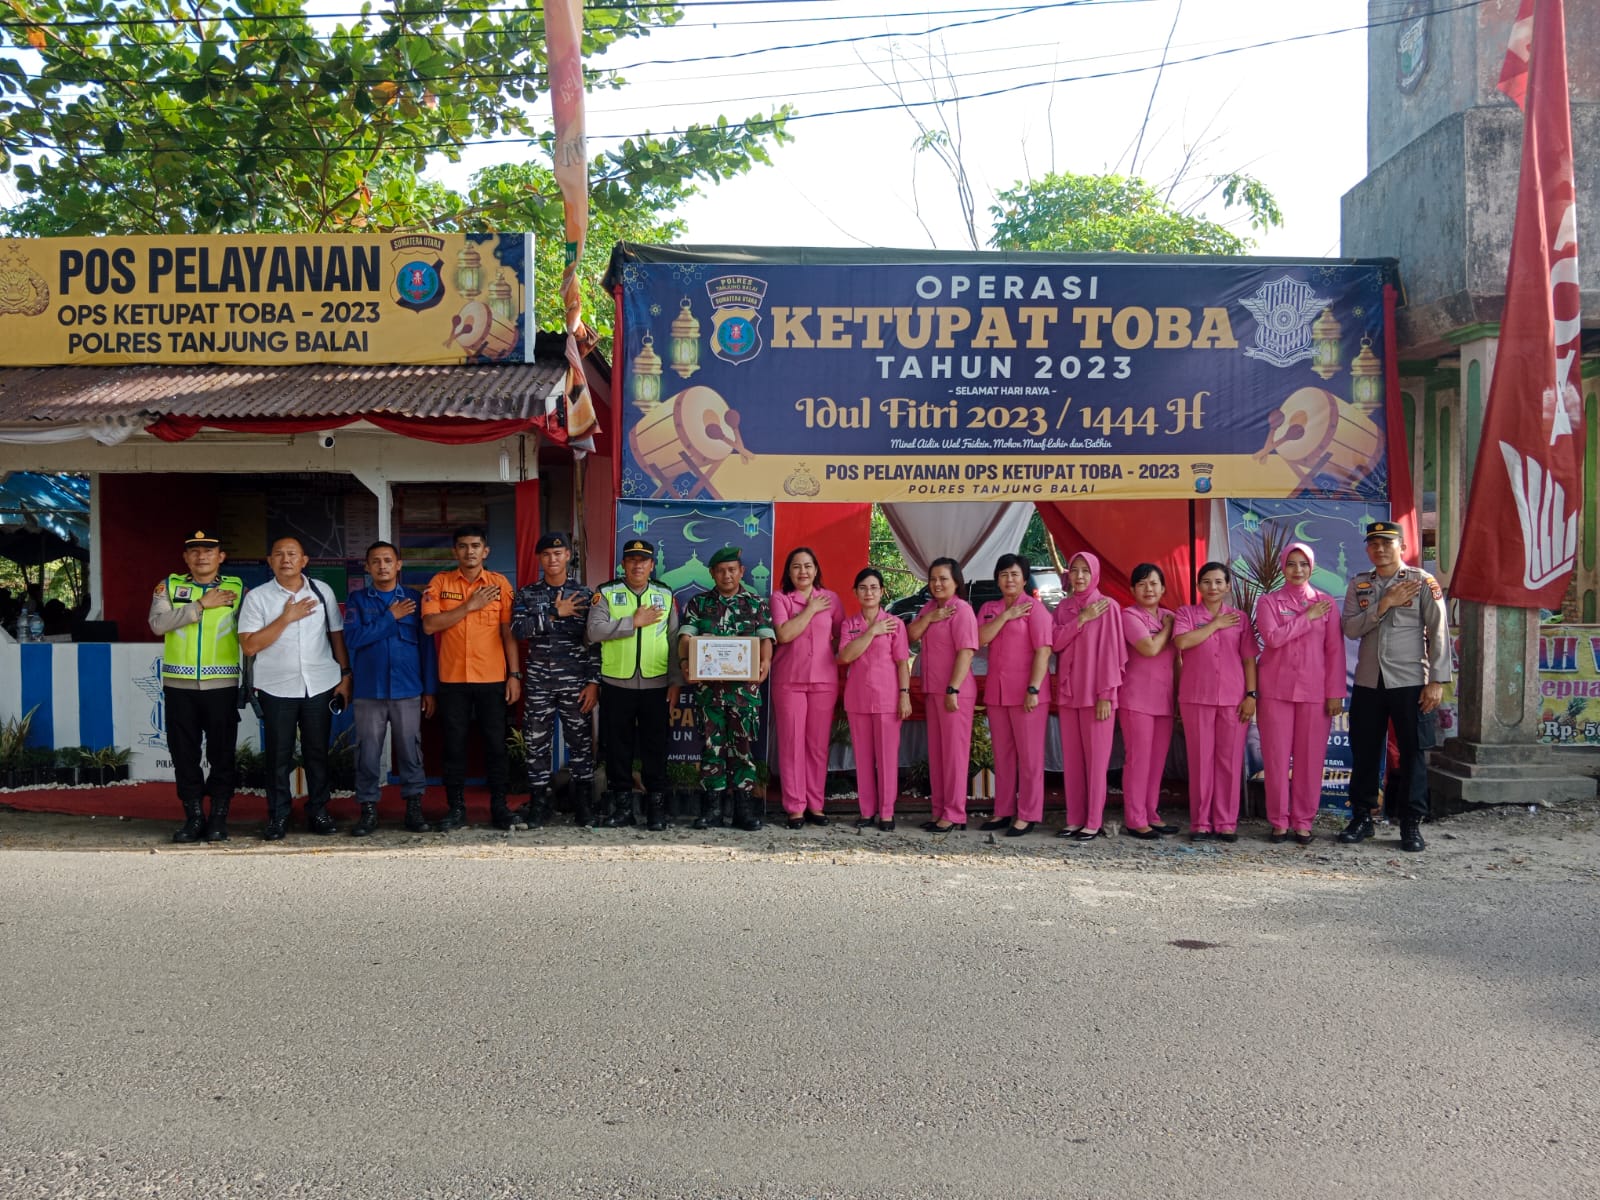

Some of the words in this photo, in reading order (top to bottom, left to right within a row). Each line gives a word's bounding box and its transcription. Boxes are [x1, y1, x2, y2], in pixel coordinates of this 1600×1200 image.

[59, 248, 136, 295] POS
[148, 246, 381, 292] PELAYANAN
[915, 275, 1098, 300] OPERASI
[57, 304, 107, 326] OPS
[113, 303, 220, 325] KETUPAT
[225, 302, 295, 324] TOBA
[321, 302, 381, 324] 2023
[770, 306, 1058, 349] KETUPAT
[1072, 306, 1239, 350] TOBA
[68, 332, 162, 354] POLRES
[168, 331, 289, 353] TANJUNG
[295, 331, 369, 352] BALAI
[876, 355, 1013, 379] TAHUN
[1034, 355, 1132, 379] 2023
[955, 386, 999, 396] SELAMAT
[1000, 386, 1023, 396] HARI
[1025, 386, 1050, 396] RAYA
[795, 396, 871, 429] Idul
[879, 398, 958, 429] Fitri
[966, 406, 1048, 436] 2023
[1055, 397, 1072, 430] /
[1079, 406, 1159, 436] 1444
[1164, 391, 1211, 435] H
[890, 438, 916, 449] Minal
[917, 438, 940, 449] Aidin
[993, 438, 1021, 449] Mohon
[1022, 438, 1047, 451] Maaf
[1069, 438, 1084, 449] dan
[1084, 438, 1113, 449] Bathin
[825, 465, 859, 481] POS
[863, 464, 960, 481] PELAYANAN
[964, 464, 998, 480] OPS
[1002, 464, 1074, 480] KETUPAT
[1079, 464, 1122, 480] TOBA
[1138, 463, 1180, 480] 2023
[908, 484, 965, 494] POLRES
[973, 484, 1043, 494] TANJUNG
[1050, 484, 1096, 493] BALAI
[1544, 721, 1578, 740] Rp.
